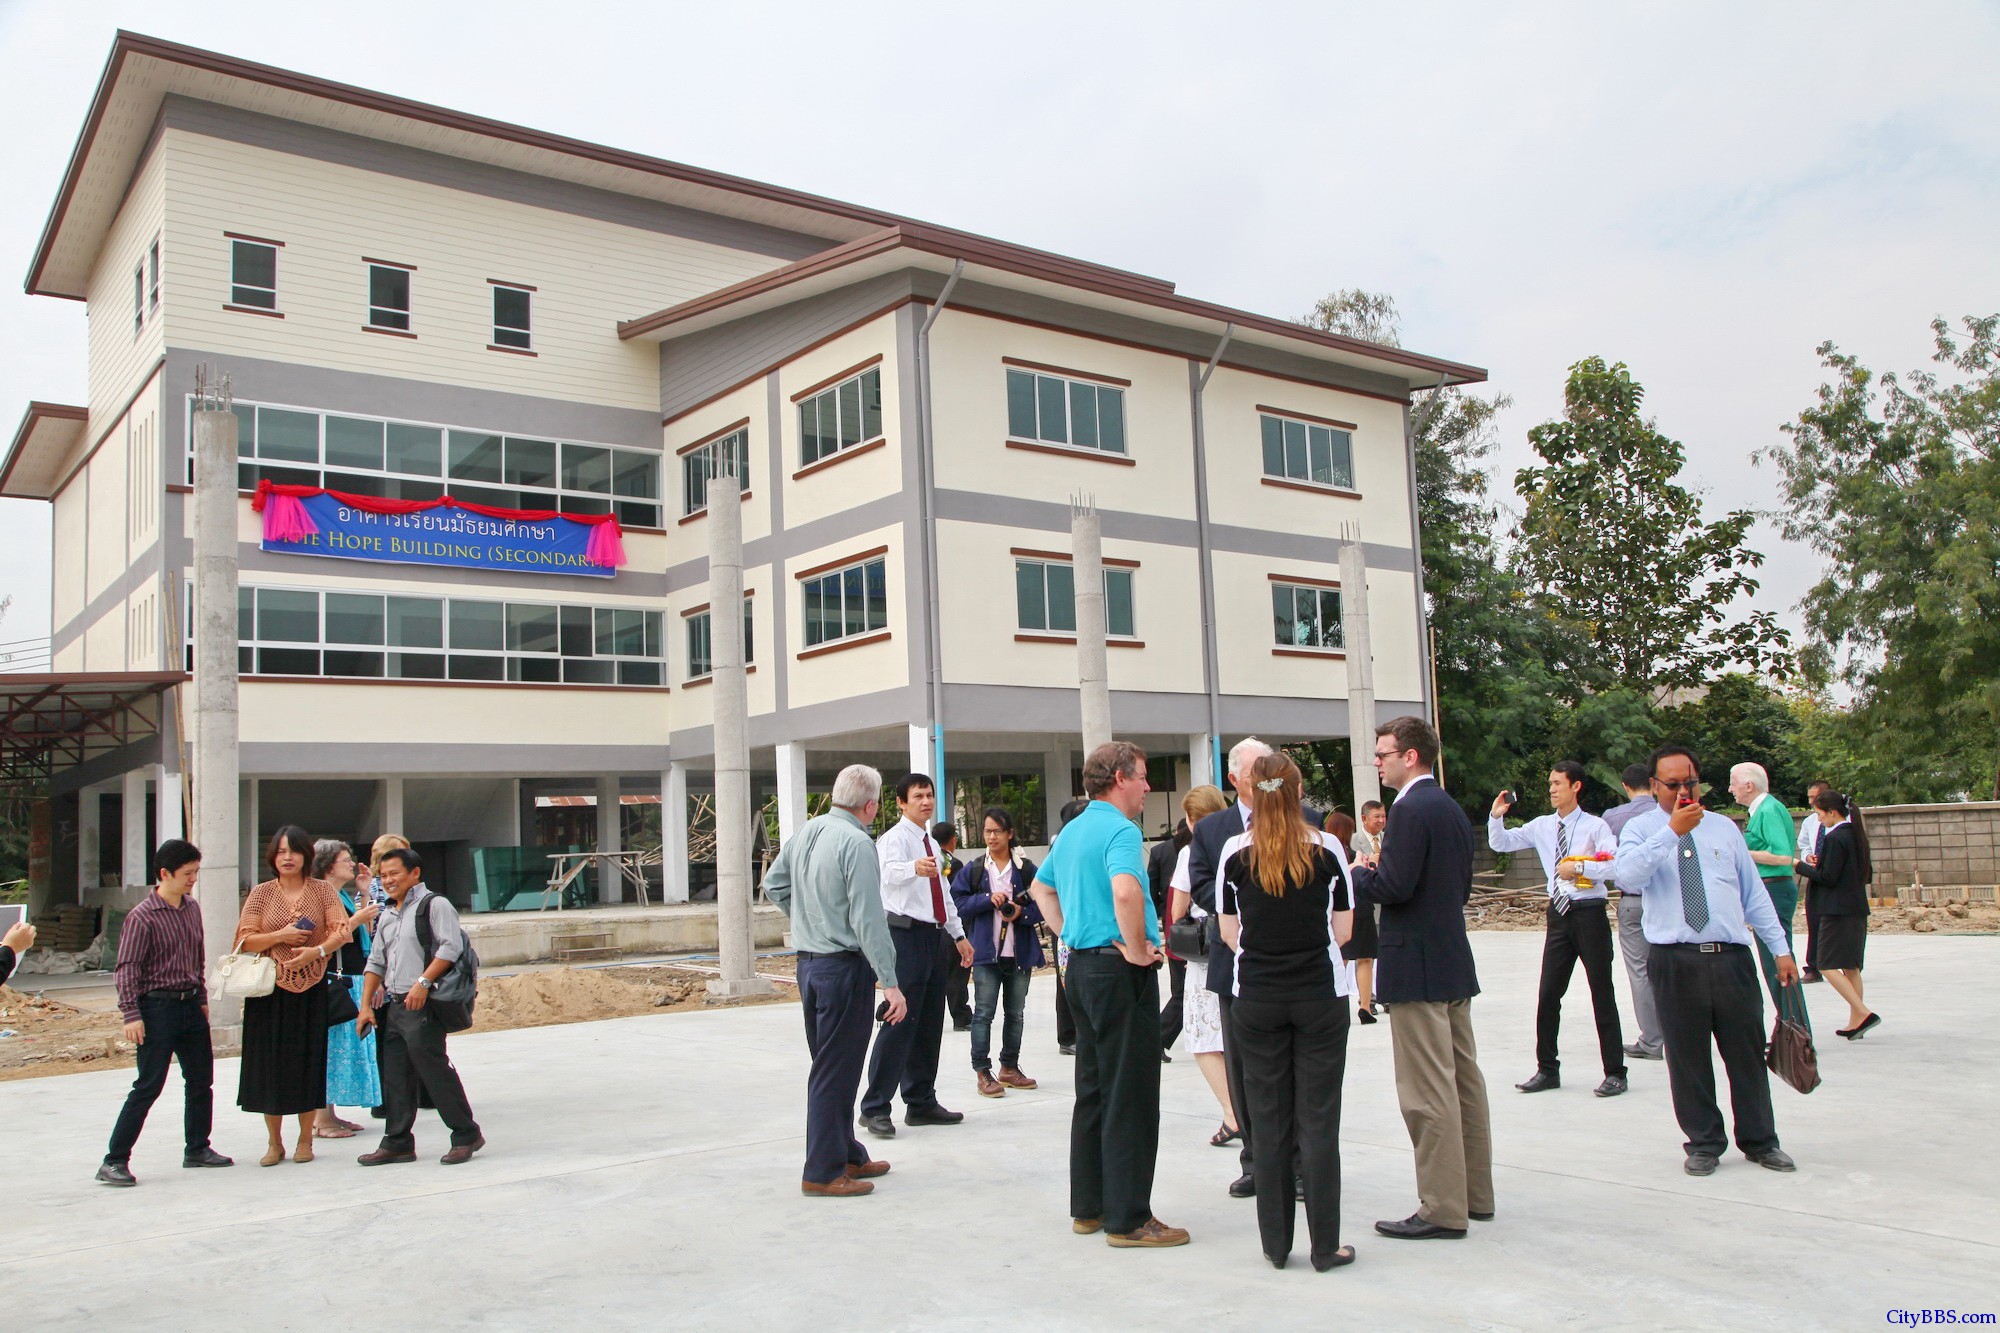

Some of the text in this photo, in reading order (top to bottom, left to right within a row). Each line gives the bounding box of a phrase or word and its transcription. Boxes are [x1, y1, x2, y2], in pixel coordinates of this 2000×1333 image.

[281, 531, 320, 546] HE
[329, 531, 382, 551] HOPE
[391, 537, 481, 560] BUILDING
